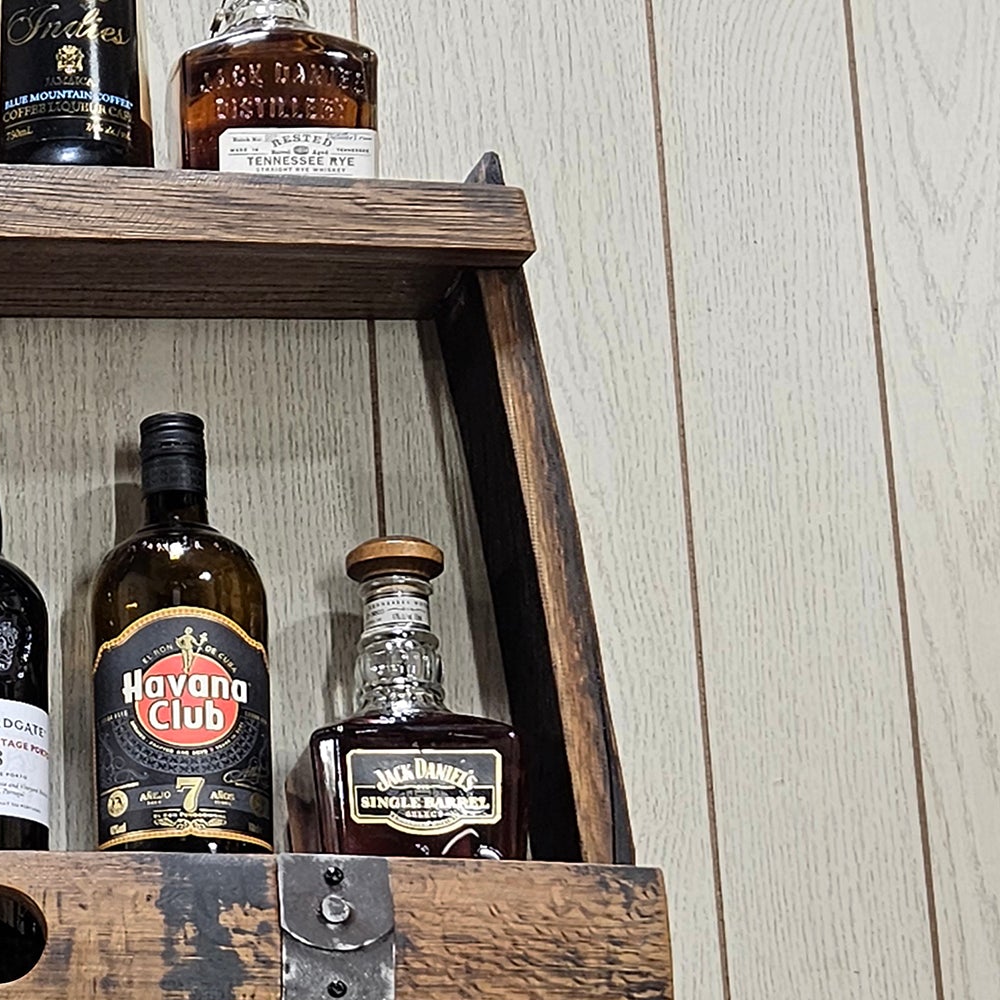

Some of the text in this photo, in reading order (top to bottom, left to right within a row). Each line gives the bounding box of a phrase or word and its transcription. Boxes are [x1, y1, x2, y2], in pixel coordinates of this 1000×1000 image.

[4, 95, 28, 110] BLUE
[29, 89, 92, 102] MOUNTAIN
[271, 134, 332, 148] RESTED
[247, 156, 356, 167] TENNESSEE RYE
[122, 668, 249, 704] Havana
[148, 700, 225, 731] Club
[373, 757, 479, 792] JACK DANIEL'S
[139, 790, 172, 802] AÑEJO
[175, 776, 205, 813] 7
[361, 796, 490, 810] SINGLE BARREL
